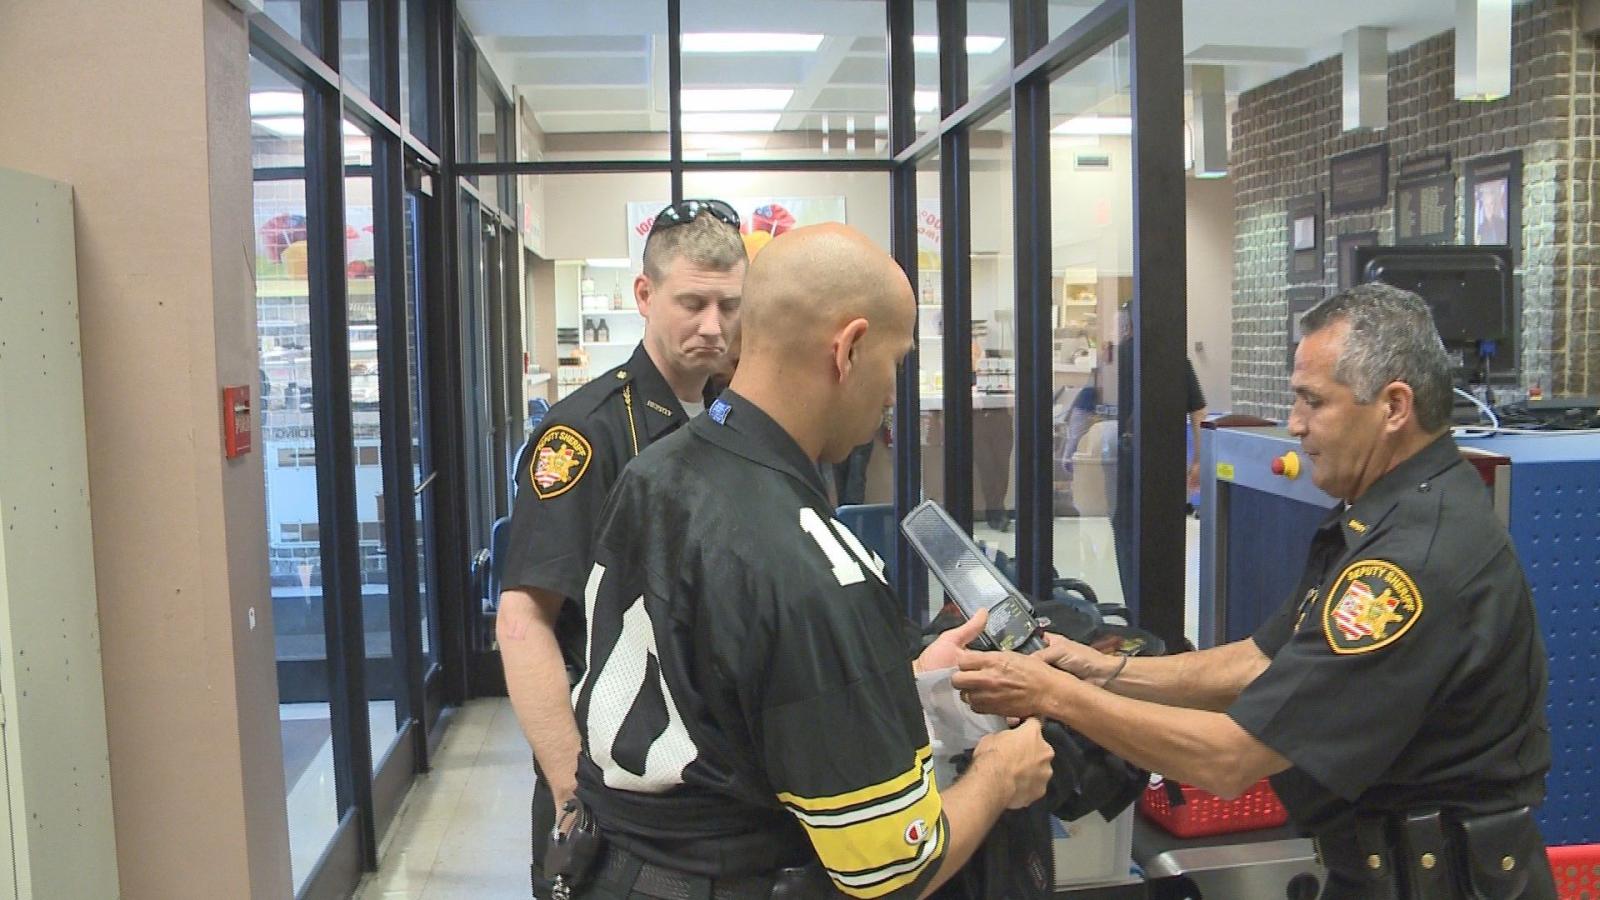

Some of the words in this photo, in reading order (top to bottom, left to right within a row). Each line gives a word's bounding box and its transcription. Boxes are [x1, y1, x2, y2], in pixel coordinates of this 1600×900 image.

[559, 431, 586, 456] SHERIFF
[1346, 566, 1388, 581] DEPUTY
[1383, 569, 1415, 612] SHERIFF
